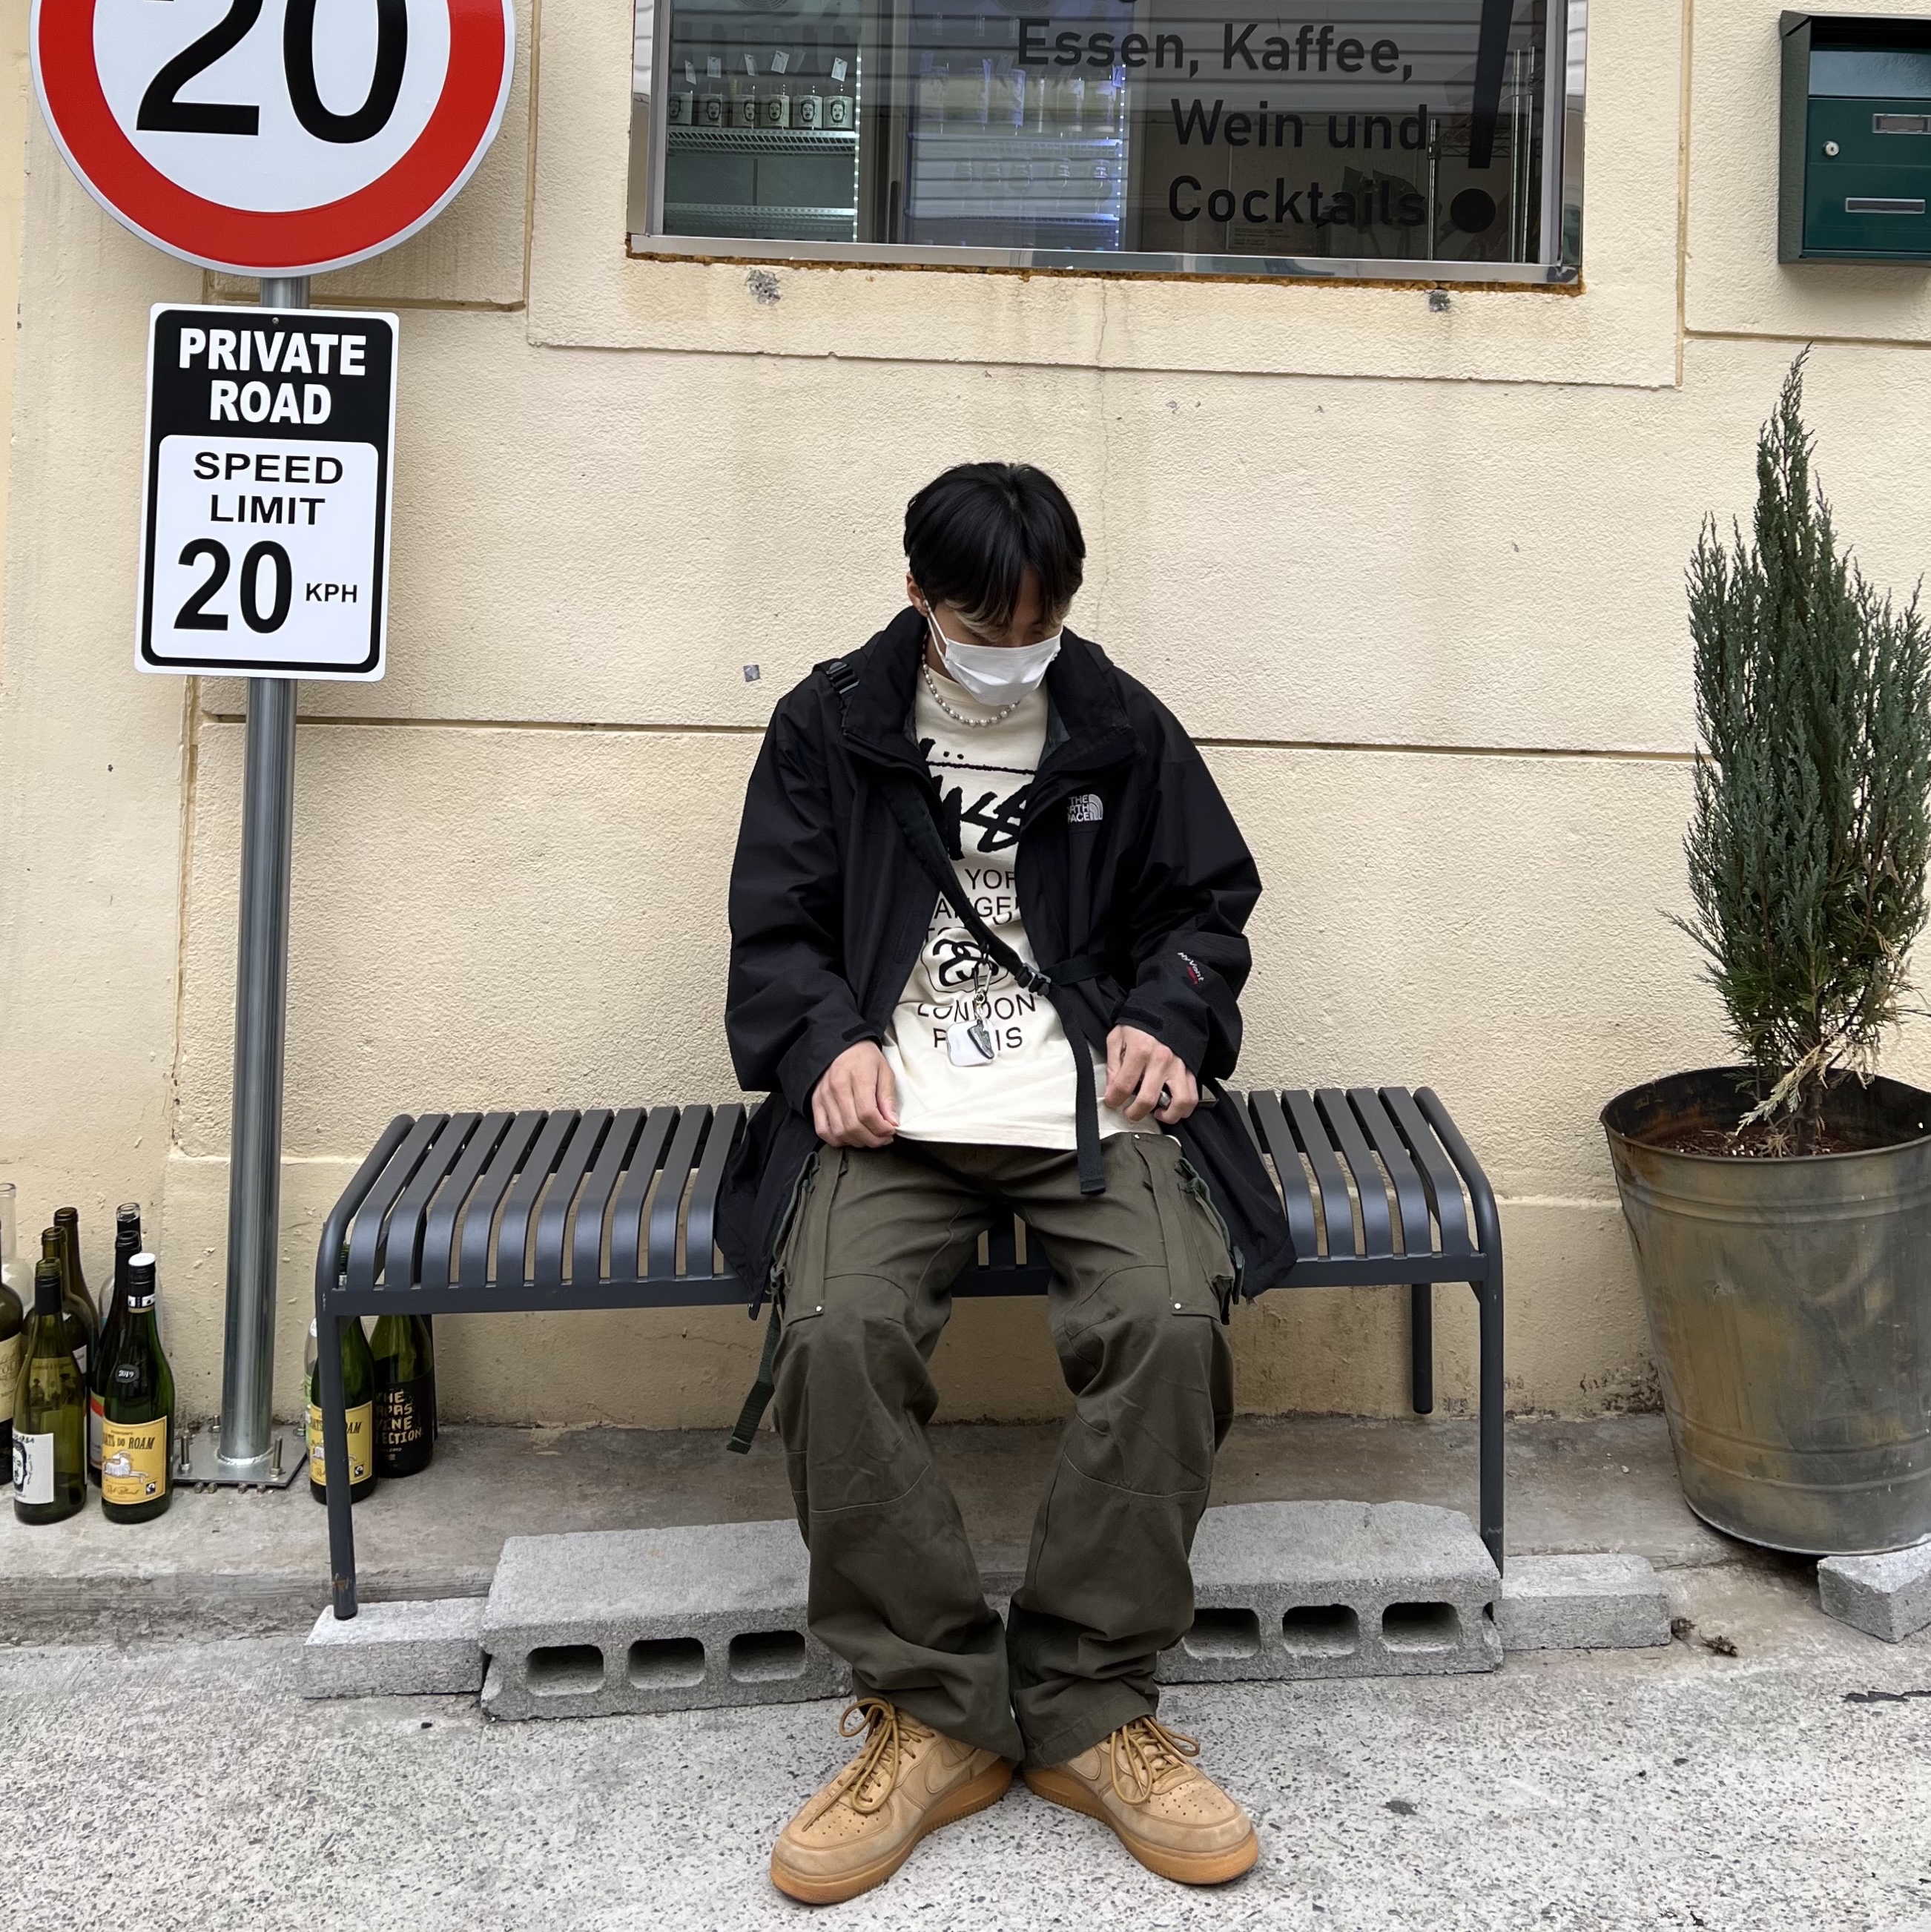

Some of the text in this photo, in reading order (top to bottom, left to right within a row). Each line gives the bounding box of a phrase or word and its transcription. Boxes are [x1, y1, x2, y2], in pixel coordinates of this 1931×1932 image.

[1017, 18, 1413, 82] Essen, Kaffee,
[136, 0, 409, 145] 20
[1170, 98, 1427, 151] Wein und
[1169, 175, 1426, 226] Cocktails
[179, 327, 367, 376] PRIVATE
[209, 380, 331, 424] ROAD
[193, 452, 343, 484] SPEED
[211, 495, 326, 525] LIMIT
[173, 538, 358, 634] 20 KPH
[1066, 803, 1089, 814] RTH
[1068, 794, 1089, 806] THE
[933, 1027, 1023, 1051] PIS
[128, 1437, 156, 1450] ROAM
